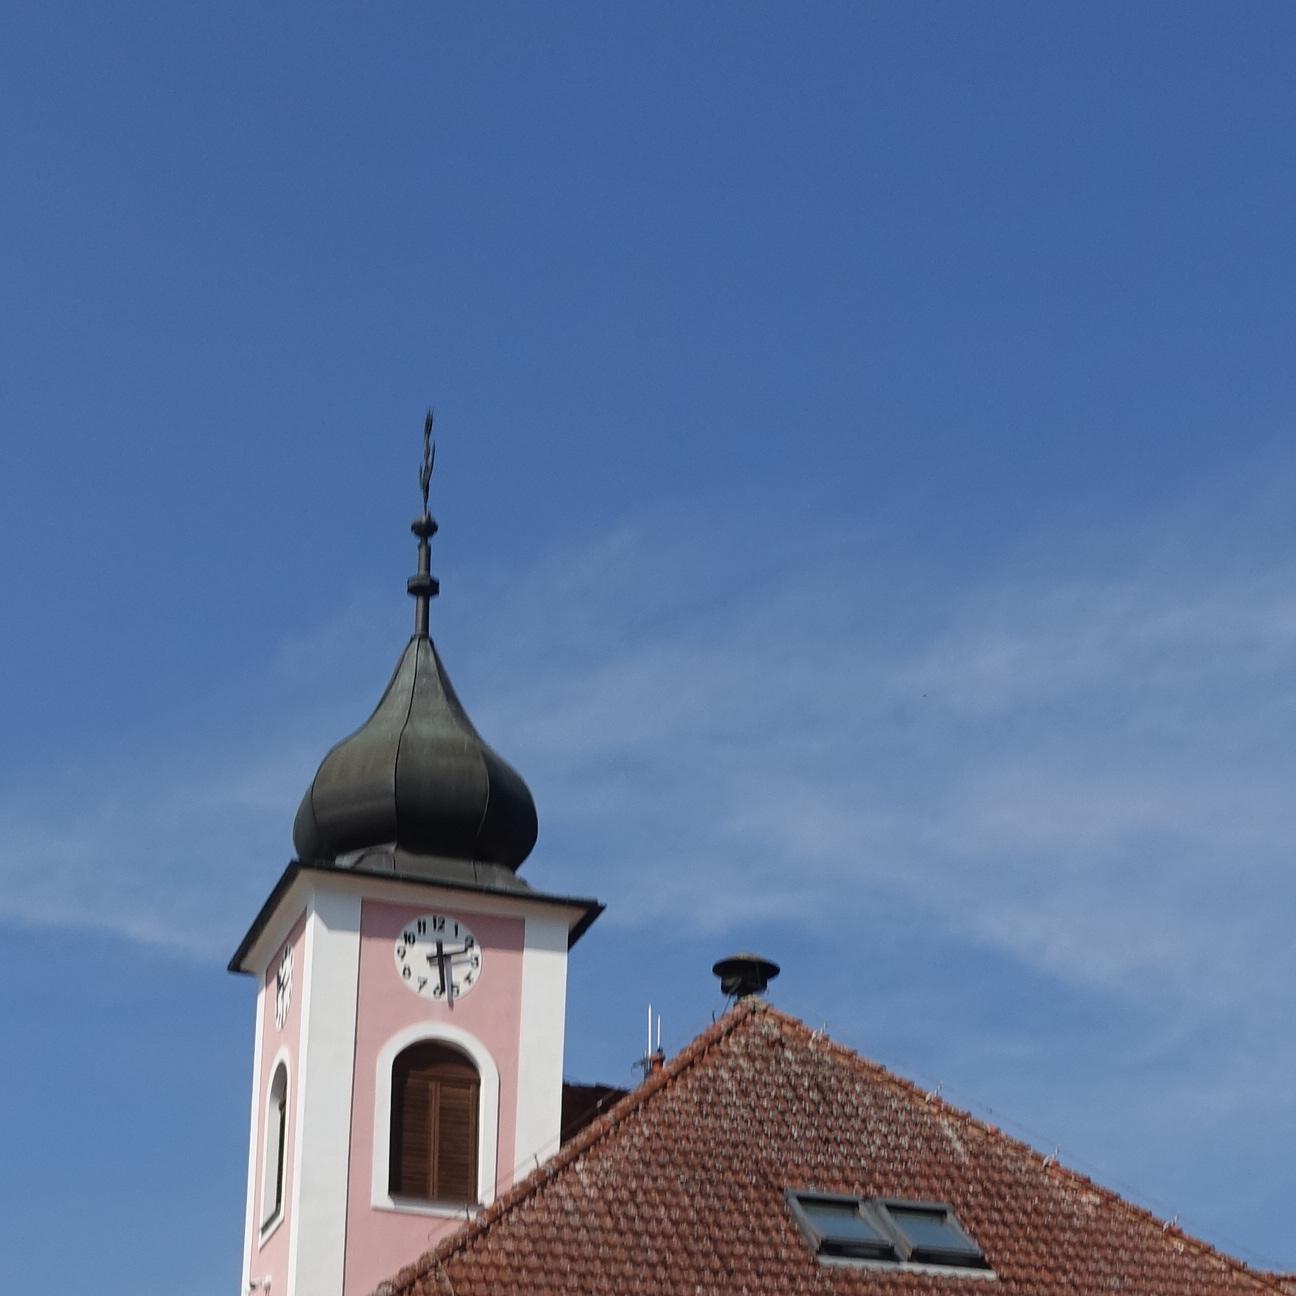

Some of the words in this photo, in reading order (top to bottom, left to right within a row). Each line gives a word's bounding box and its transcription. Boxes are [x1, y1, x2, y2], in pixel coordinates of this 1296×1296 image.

[418, 919, 426, 934] 11
[433, 915, 445, 932] 12
[454, 922, 458, 938] 1
[404, 931, 416, 946] 10
[465, 935, 474, 952] 2
[397, 947, 406, 960] 9
[471, 955, 479, 969] 3
[403, 966, 411, 979] 8
[465, 971, 473, 985] 4
[418, 976, 427, 992] 7
